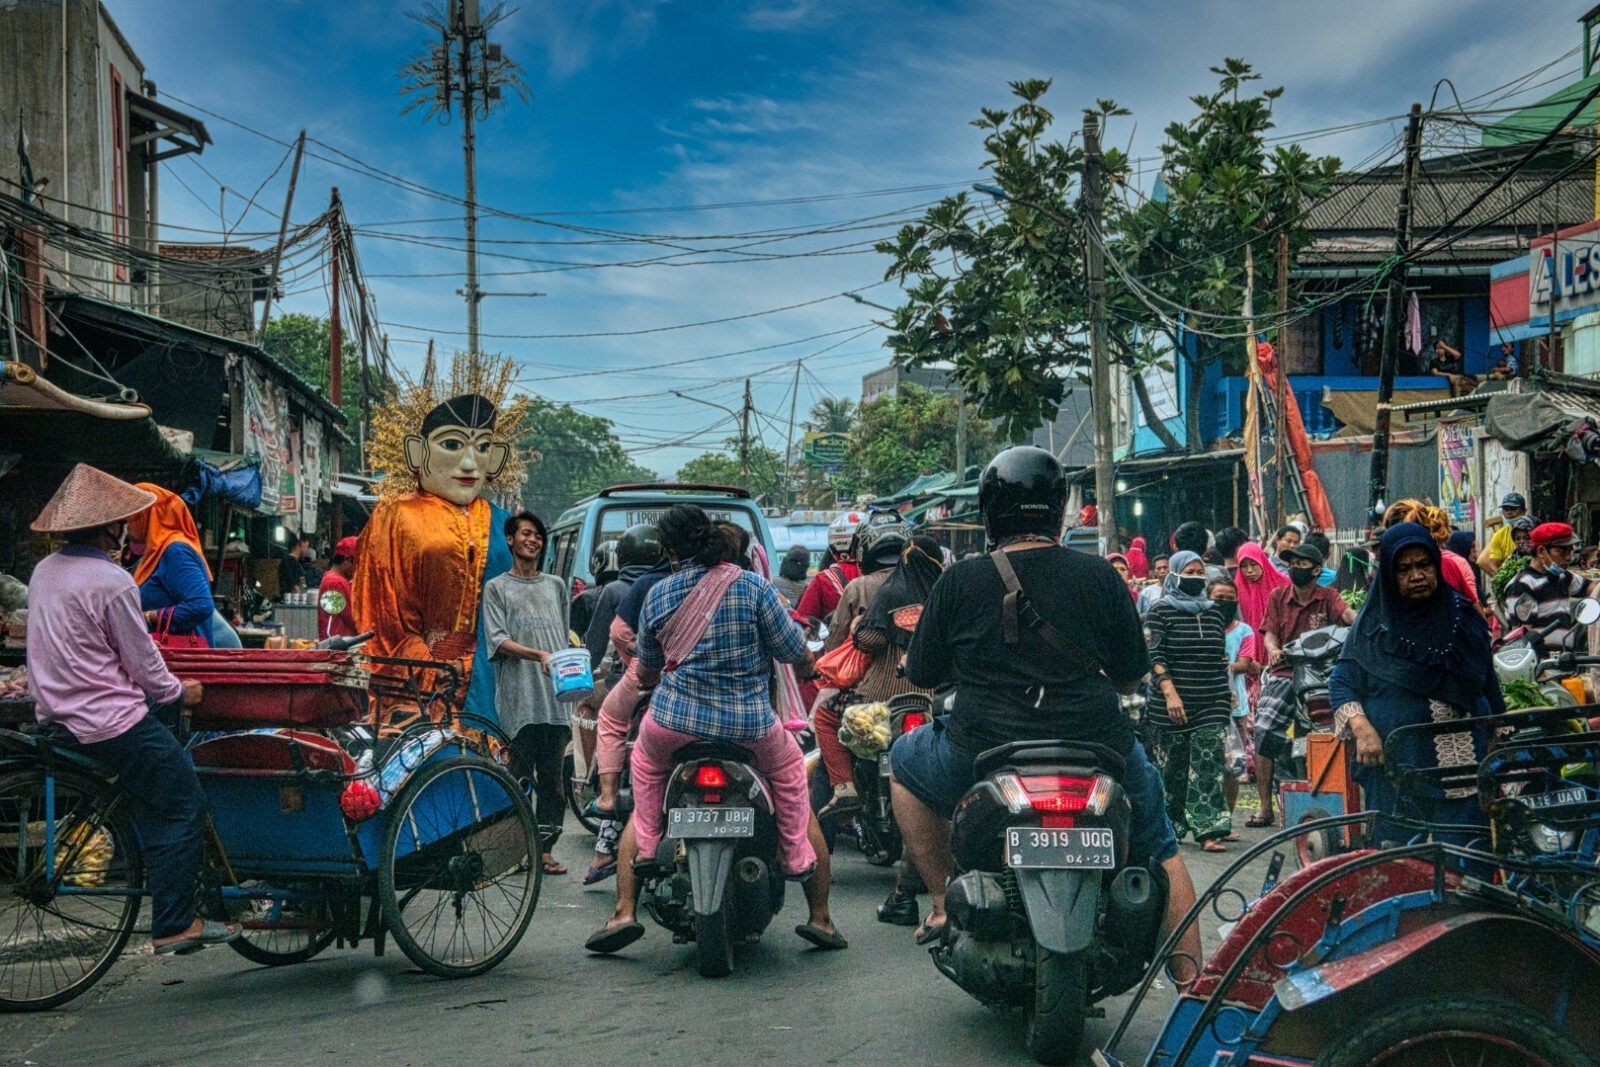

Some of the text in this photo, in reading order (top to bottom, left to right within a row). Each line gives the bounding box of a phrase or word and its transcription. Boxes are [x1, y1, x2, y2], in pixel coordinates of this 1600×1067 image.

[674, 811, 681, 822] B
[688, 811, 719, 822] 3737
[1010, 832, 1111, 847] B 3919 UQG
